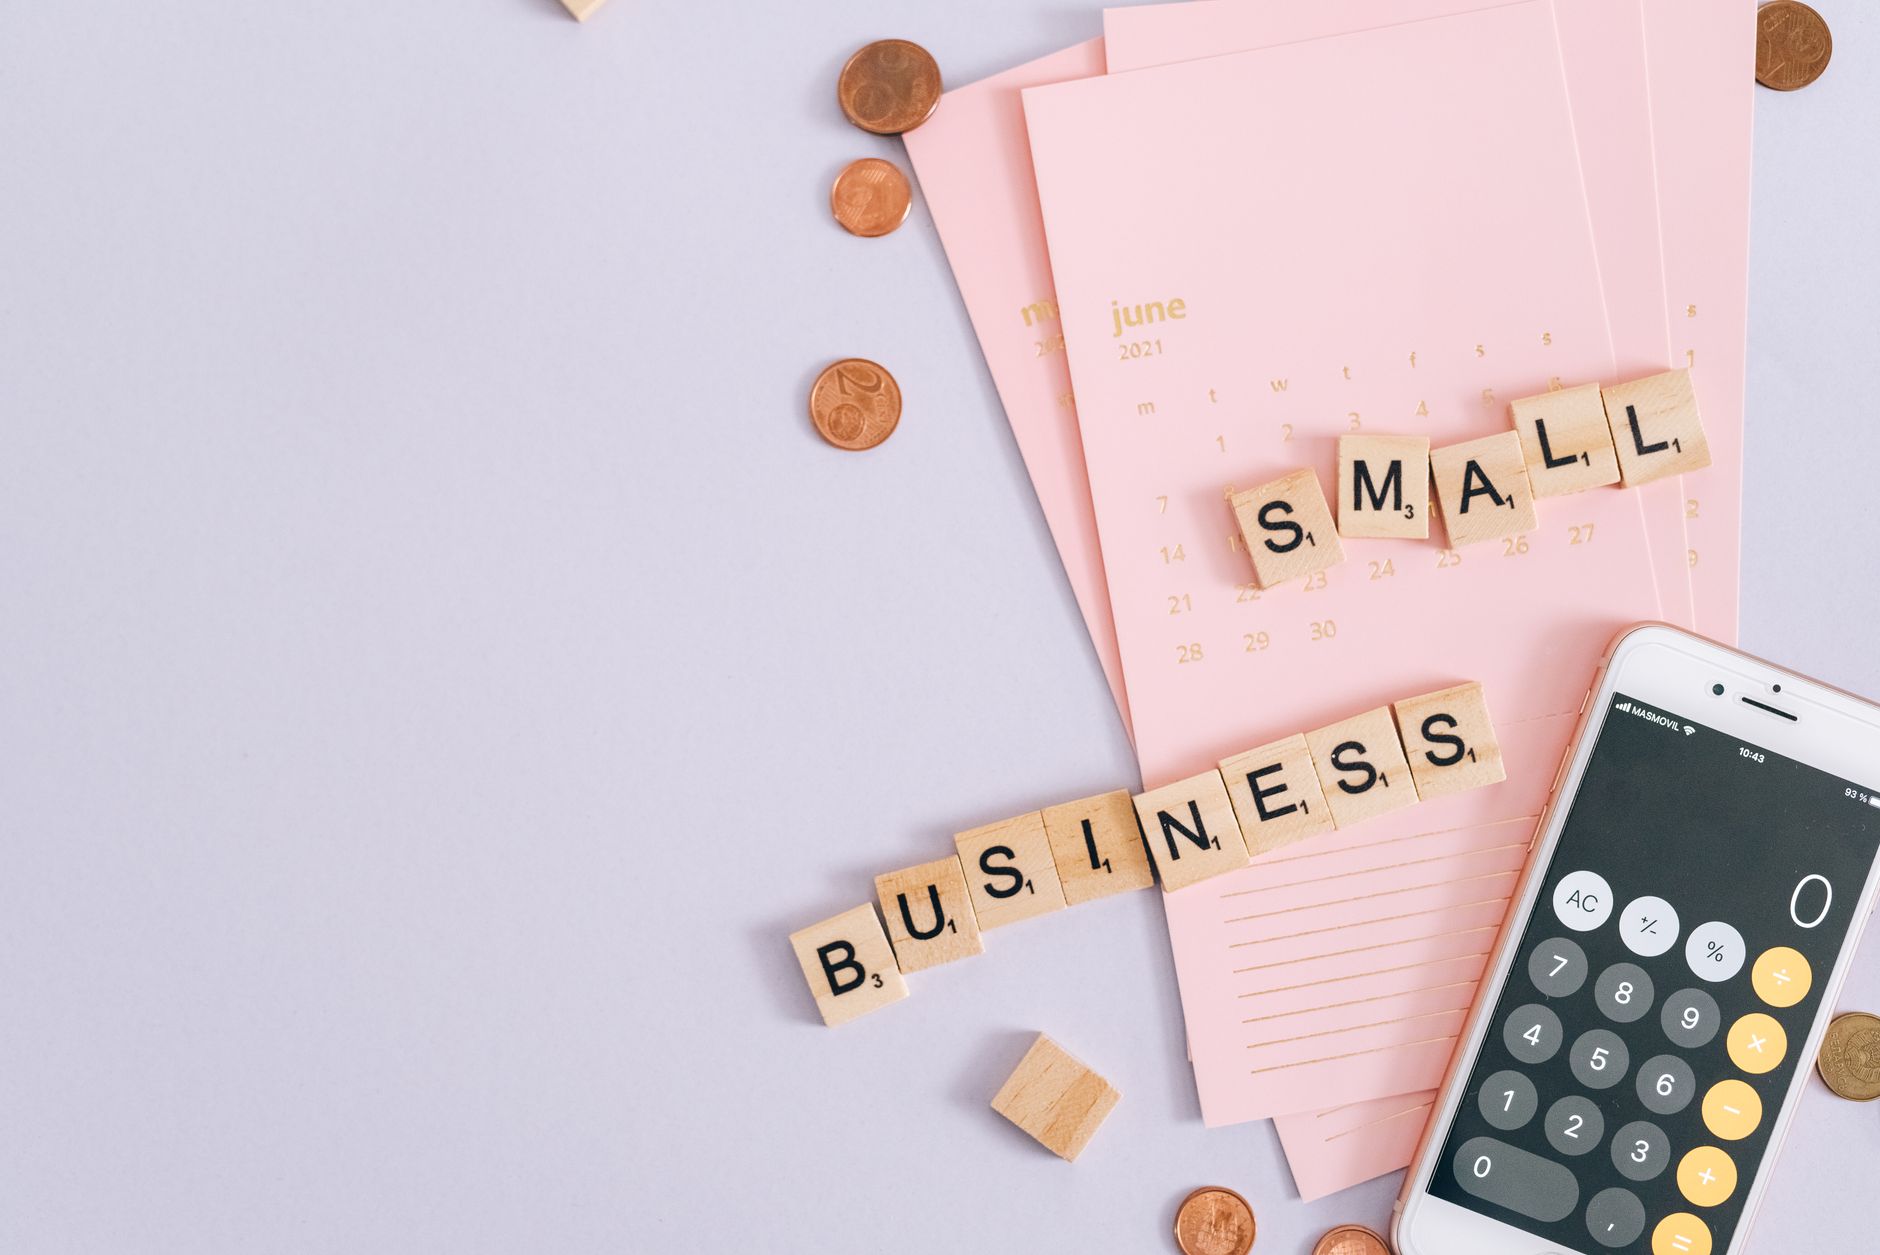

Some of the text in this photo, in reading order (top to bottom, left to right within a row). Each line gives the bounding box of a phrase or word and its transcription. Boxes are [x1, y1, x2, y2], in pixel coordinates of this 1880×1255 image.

[1111, 297, 1187, 338] june
[1686, 303, 1697, 318] s
[1118, 338, 1163, 361] 2021
[1685, 349, 1694, 368] 1
[1136, 401, 1156, 416] m
[1208, 388, 1218, 403] t
[1270, 378, 1289, 392] w
[1342, 366, 1352, 380] t
[1409, 351, 1416, 369] f
[1542, 332, 1552, 346] s
[1215, 434, 1226, 453] 1
[1281, 423, 1294, 442] 2
[1347, 412, 1361, 431] 3
[1415, 399, 1429, 417] 4
[1672, 438, 1681, 453] 1
[1581, 451, 1590, 466] 1
[1257, 405, 1670, 554] SMALL
[1156, 495, 1168, 514] 7
[1404, 504, 1414, 520] 3
[1505, 495, 1515, 509] 1
[1684, 499, 1699, 518] 2
[1306, 532, 1316, 546] 1
[1160, 544, 1186, 564] 14
[1168, 594, 1192, 615] 21
[1302, 570, 1328, 592] 23
[1368, 559, 1395, 581] 24
[1502, 535, 1529, 557] 26
[1568, 523, 1595, 545] 27
[1176, 620, 1336, 664] 28 29 30
[1631, 705, 1680, 732] MASMOVIL
[1467, 747, 1476, 763] 1
[1738, 746, 1766, 764] 10:43
[1379, 772, 1389, 787] 1
[1844, 787, 1858, 799] 93
[1299, 799, 1309, 815] 1
[1211, 835, 1221, 851] 1
[816, 713, 1466, 997] BUSINESS
[1102, 859, 1112, 874] 1
[1025, 879, 1035, 895] 1
[1565, 889, 1599, 913] AC
[1789, 873, 1834, 929] 0
[947, 919, 957, 934] 1
[1706, 940, 1724, 963] %
[1548, 954, 1569, 978] 7
[871, 973, 883, 989] 3
[1614, 981, 1635, 1005] 8
[1680, 1006, 1700, 1030] 9
[1522, 1023, 1543, 1047] 4
[1589, 1047, 1610, 1071] 5
[1655, 1072, 1676, 1097] 6
[1502, 1089, 1515, 1113] 1
[1563, 1114, 1584, 1139] 2
[1630, 1139, 1650, 1163] 3
[1473, 1155, 1493, 1178] 0
